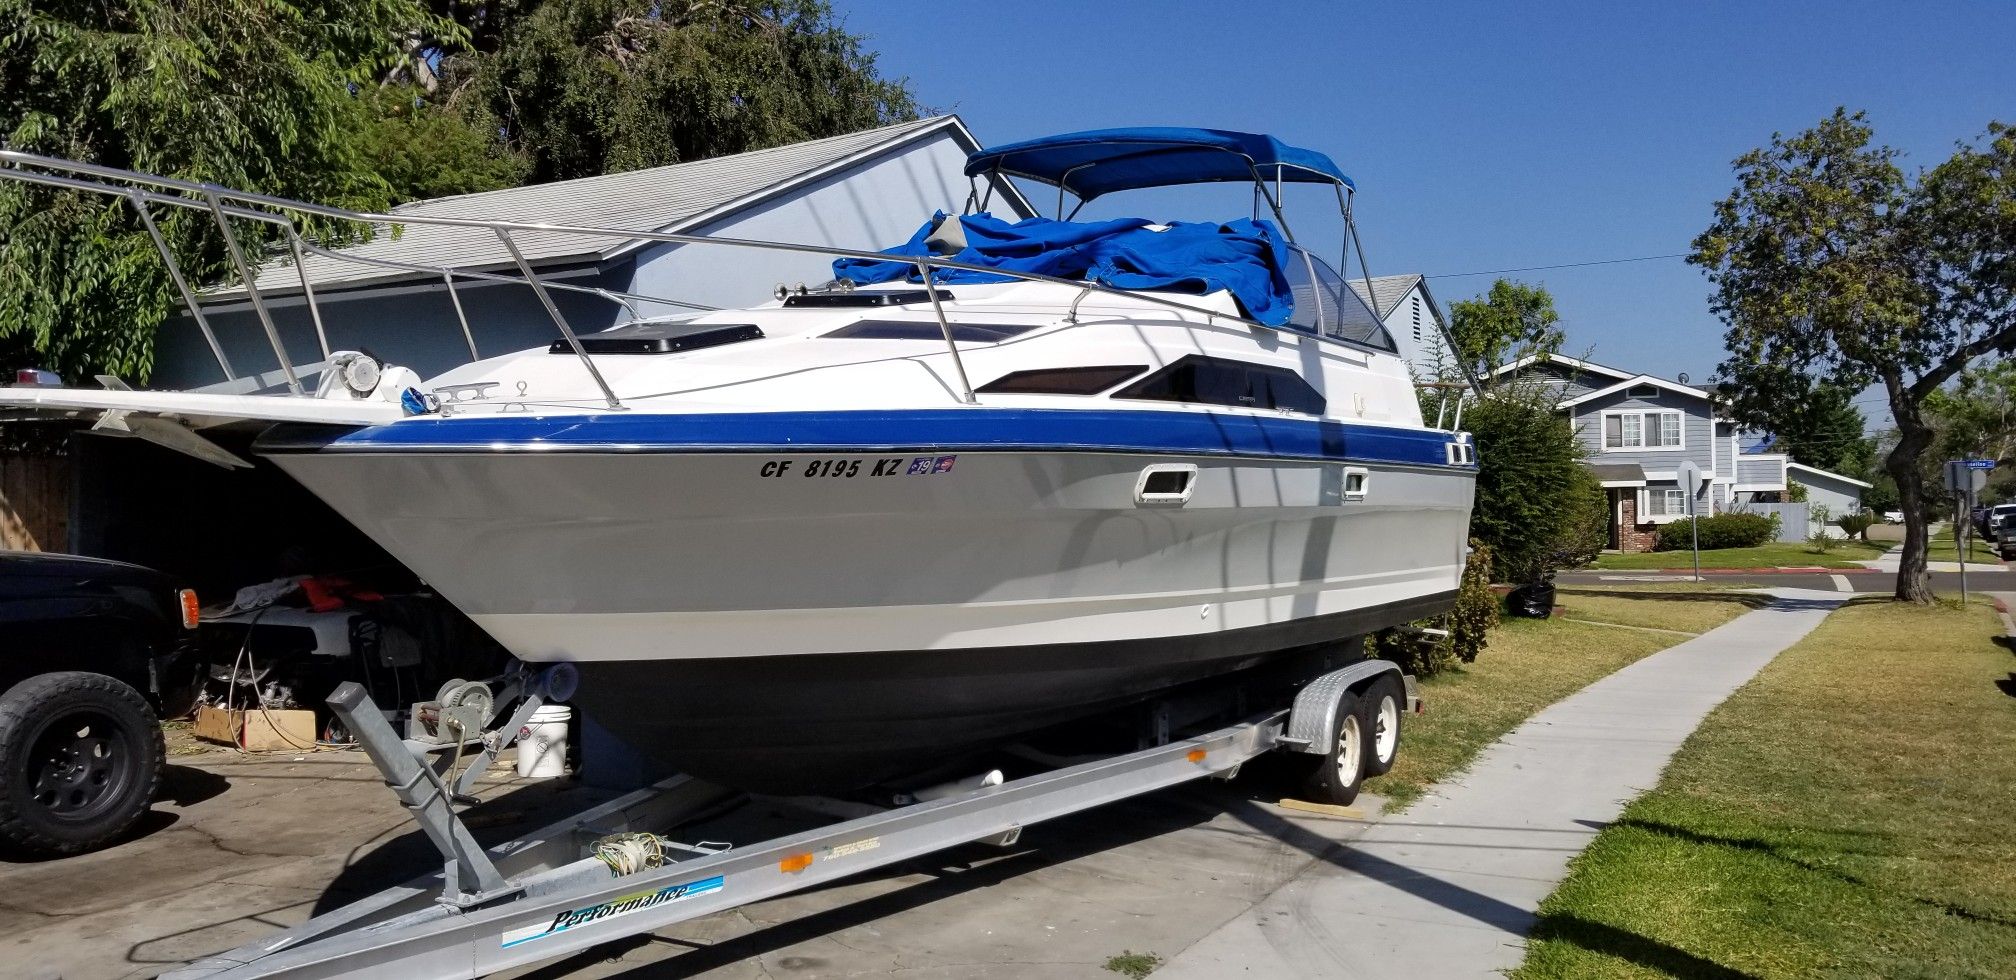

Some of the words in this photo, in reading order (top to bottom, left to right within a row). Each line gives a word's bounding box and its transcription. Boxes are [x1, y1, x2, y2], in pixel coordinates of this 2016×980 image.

[760, 461, 792, 478] CF
[804, 459, 862, 478] 8195
[870, 459, 903, 477] KZ
[917, 460, 931, 471] 19
[546, 886, 688, 934] Performance
